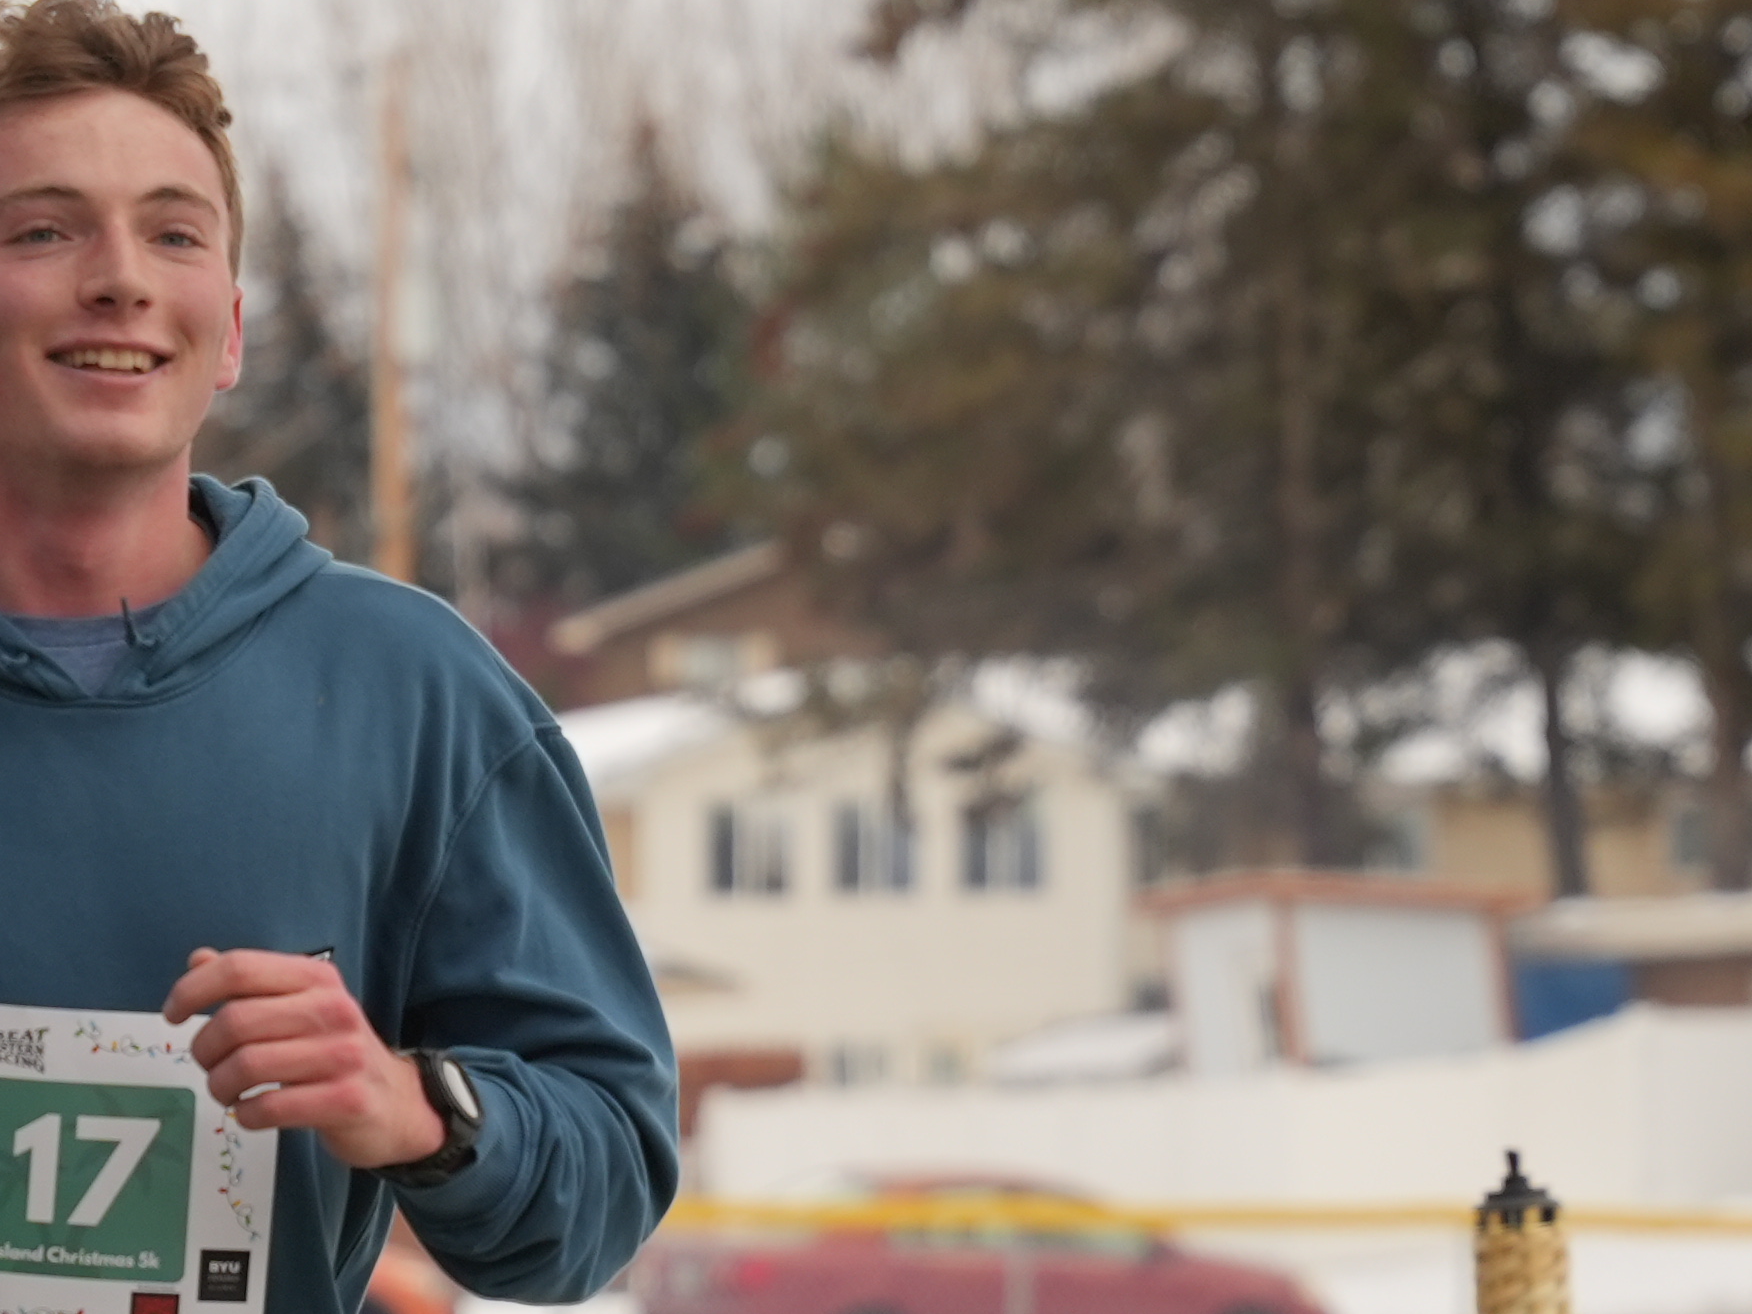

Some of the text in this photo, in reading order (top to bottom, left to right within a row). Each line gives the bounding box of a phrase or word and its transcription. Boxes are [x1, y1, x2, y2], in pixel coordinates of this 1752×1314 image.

[12, 1112, 161, 1227] 17
[46, 1245, 136, 1269] Christmas
[208, 1260, 241, 1274] BYU
